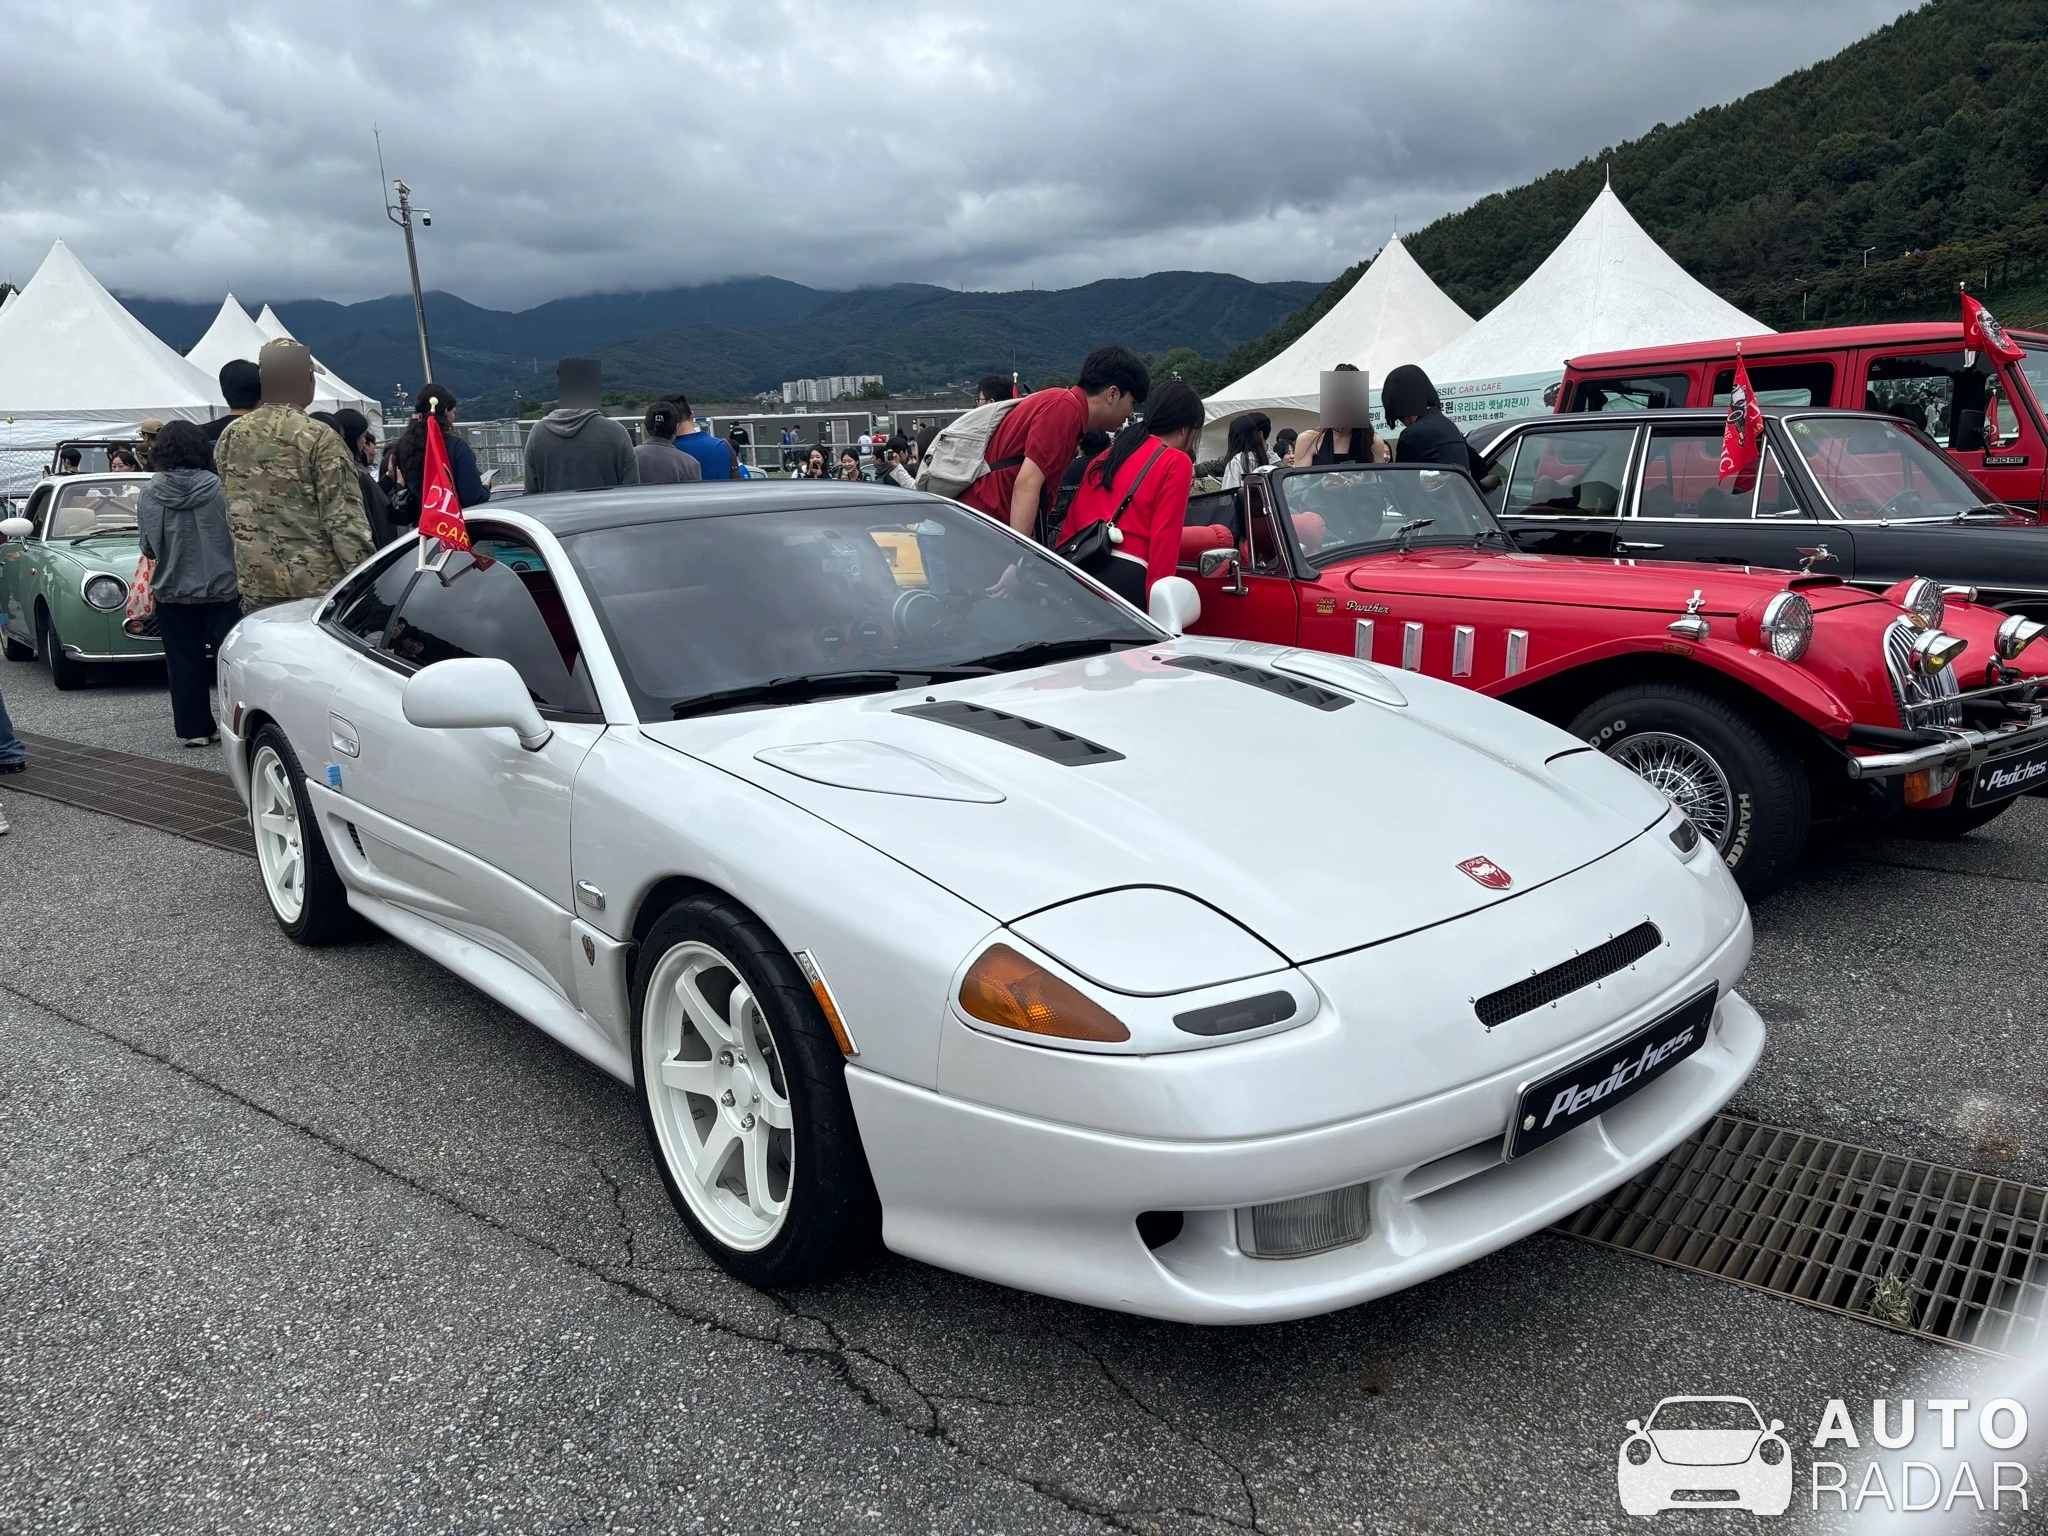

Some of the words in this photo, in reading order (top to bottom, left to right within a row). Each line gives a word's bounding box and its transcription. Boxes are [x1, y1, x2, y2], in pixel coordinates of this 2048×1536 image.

[1459, 385, 1474, 394] CAR
[1481, 382, 1502, 392] CAFE
[436, 521, 470, 547] CAR
[1346, 600, 1390, 614] Panther
[1724, 793, 1752, 868] HANKOO
